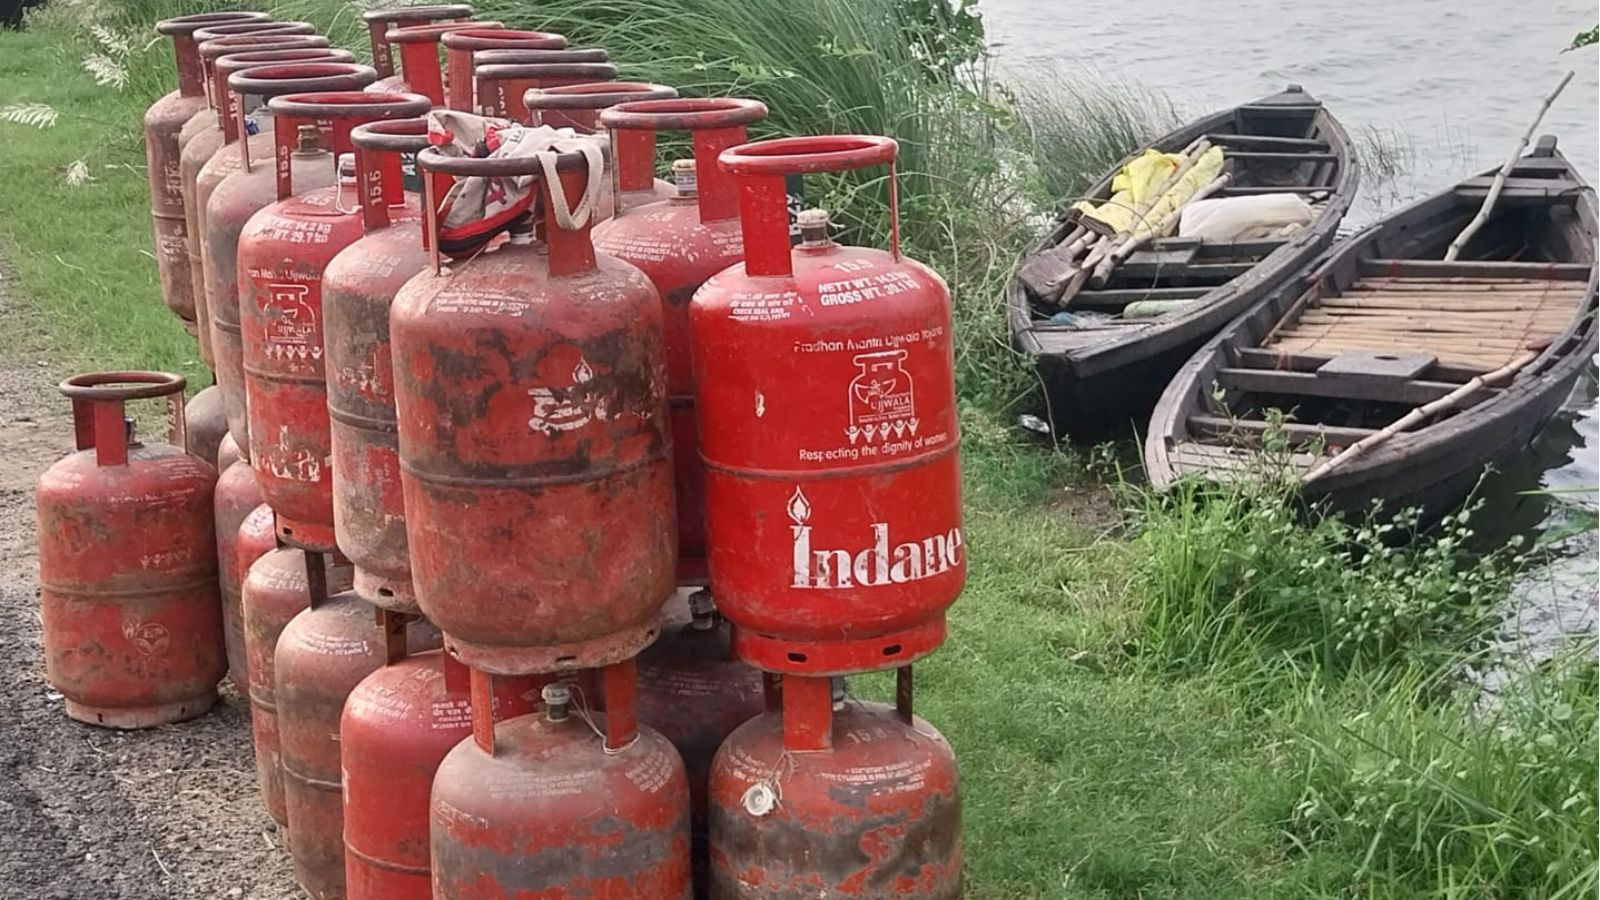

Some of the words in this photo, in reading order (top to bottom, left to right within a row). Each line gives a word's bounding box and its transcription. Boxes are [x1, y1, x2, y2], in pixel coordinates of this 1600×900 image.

[369, 170, 383, 206] 15.6
[818, 281, 852, 293] NETT
[851, 277, 877, 289] WT.
[820, 290, 862, 306] GROSS
[861, 286, 886, 300] WT.
[870, 396, 910, 413] UJJWALA
[799, 445, 859, 463] Respecting
[861, 444, 878, 457] the
[881, 440, 912, 455] dignity
[914, 436, 923, 448] of
[788, 522, 962, 589] Indane
